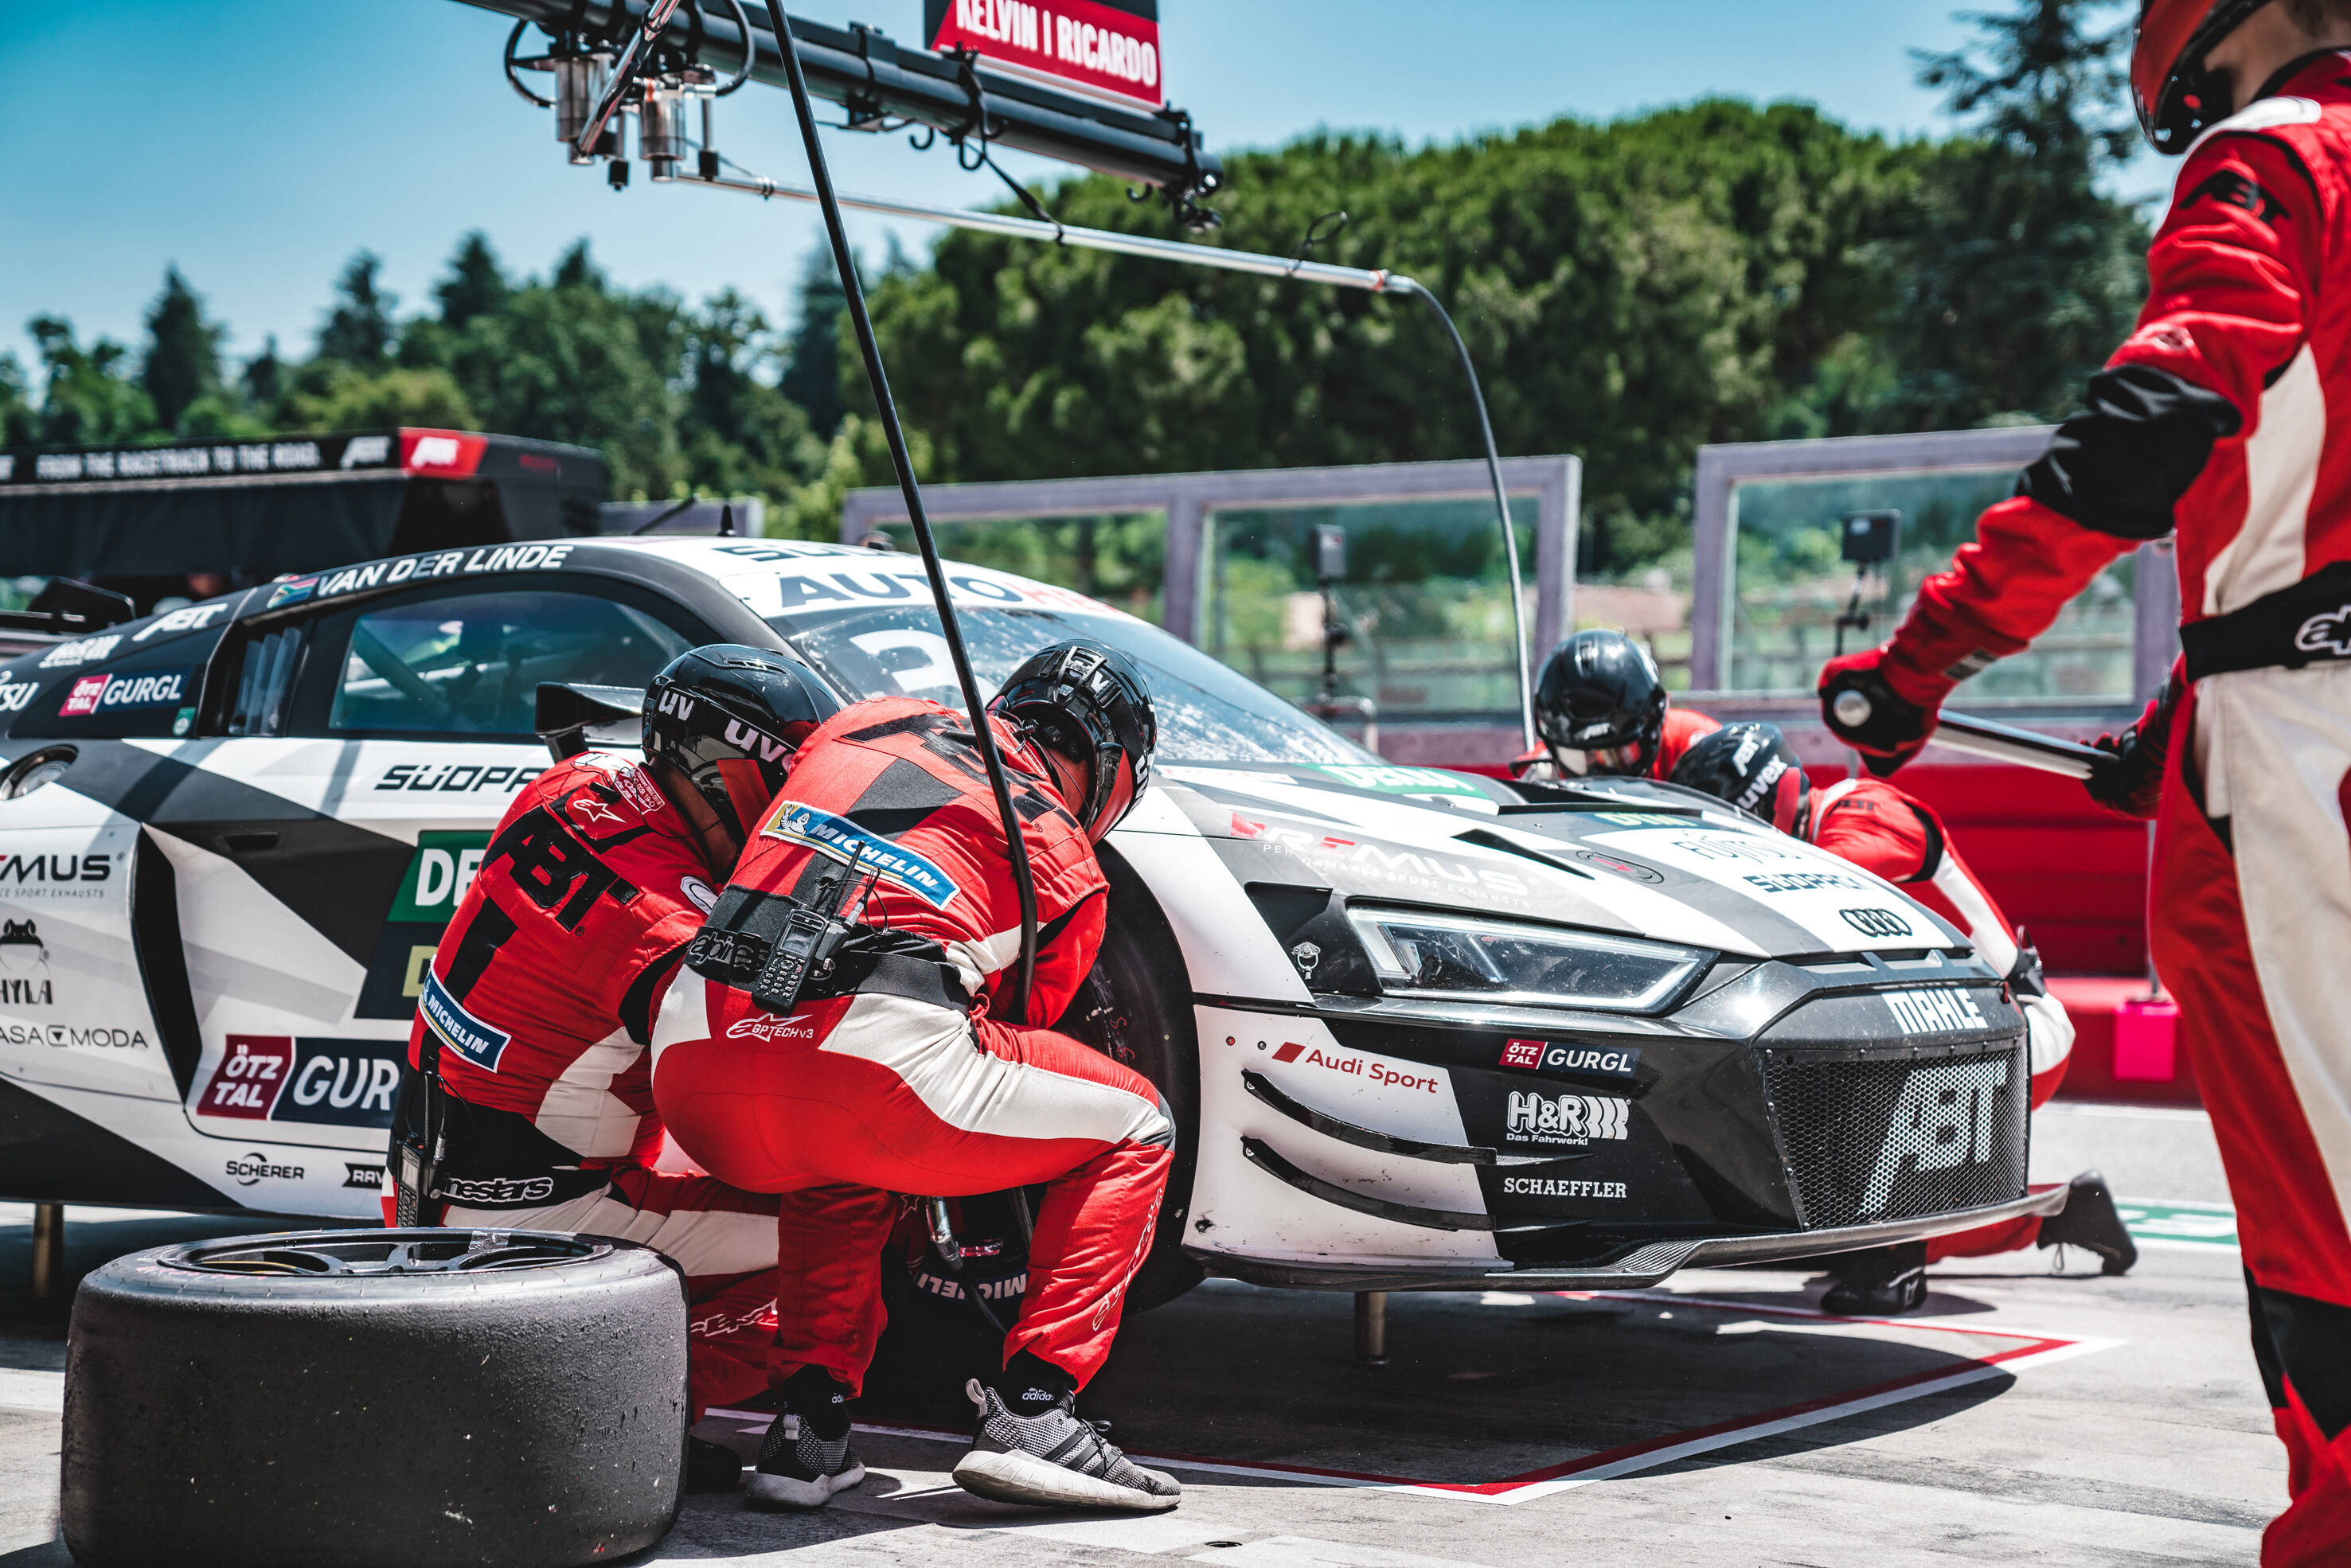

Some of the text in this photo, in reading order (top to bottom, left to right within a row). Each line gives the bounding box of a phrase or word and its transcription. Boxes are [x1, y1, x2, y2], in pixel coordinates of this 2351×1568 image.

[955, 0, 1038, 50] KELVIN
[1056, 14, 1158, 87] RICARDO
[84, 451, 115, 477] THE
[213, 445, 236, 472] TO
[239, 443, 268, 471] THE
[318, 544, 574, 598] VAN DER LINDE
[132, 603, 228, 642] ABT
[104, 673, 182, 705] GURGL
[1736, 753, 1788, 810] uvex
[810, 823, 938, 888] MICHELIN
[1264, 826, 1529, 897] REMUS
[14, 888, 47, 899] SPORT
[50, 888, 105, 899] EXHAUSTS
[1263, 843, 1530, 910] PERORMANCE SPORT EXHAUSTS
[427, 993, 490, 1055] MICHELIN
[1881, 989, 1989, 1035] MAHLE
[226, 1044, 283, 1080] ÖTZ
[1506, 1054, 1533, 1065] TAL
[1509, 1042, 1539, 1055] ÖTZ
[1547, 1048, 1632, 1072] GURGL
[1306, 1047, 1439, 1094] Audi Sport
[214, 1082, 264, 1108] TAL
[1507, 1091, 1589, 1138] H&R
[1506, 1133, 1588, 1146] Das Fahrwerk!
[1857, 1059, 2008, 1215] ABT
[225, 1159, 305, 1180] SCHERER
[1504, 1177, 1627, 1199] SCHAEFFLER
[1021, 1390, 1055, 1402] adidas
